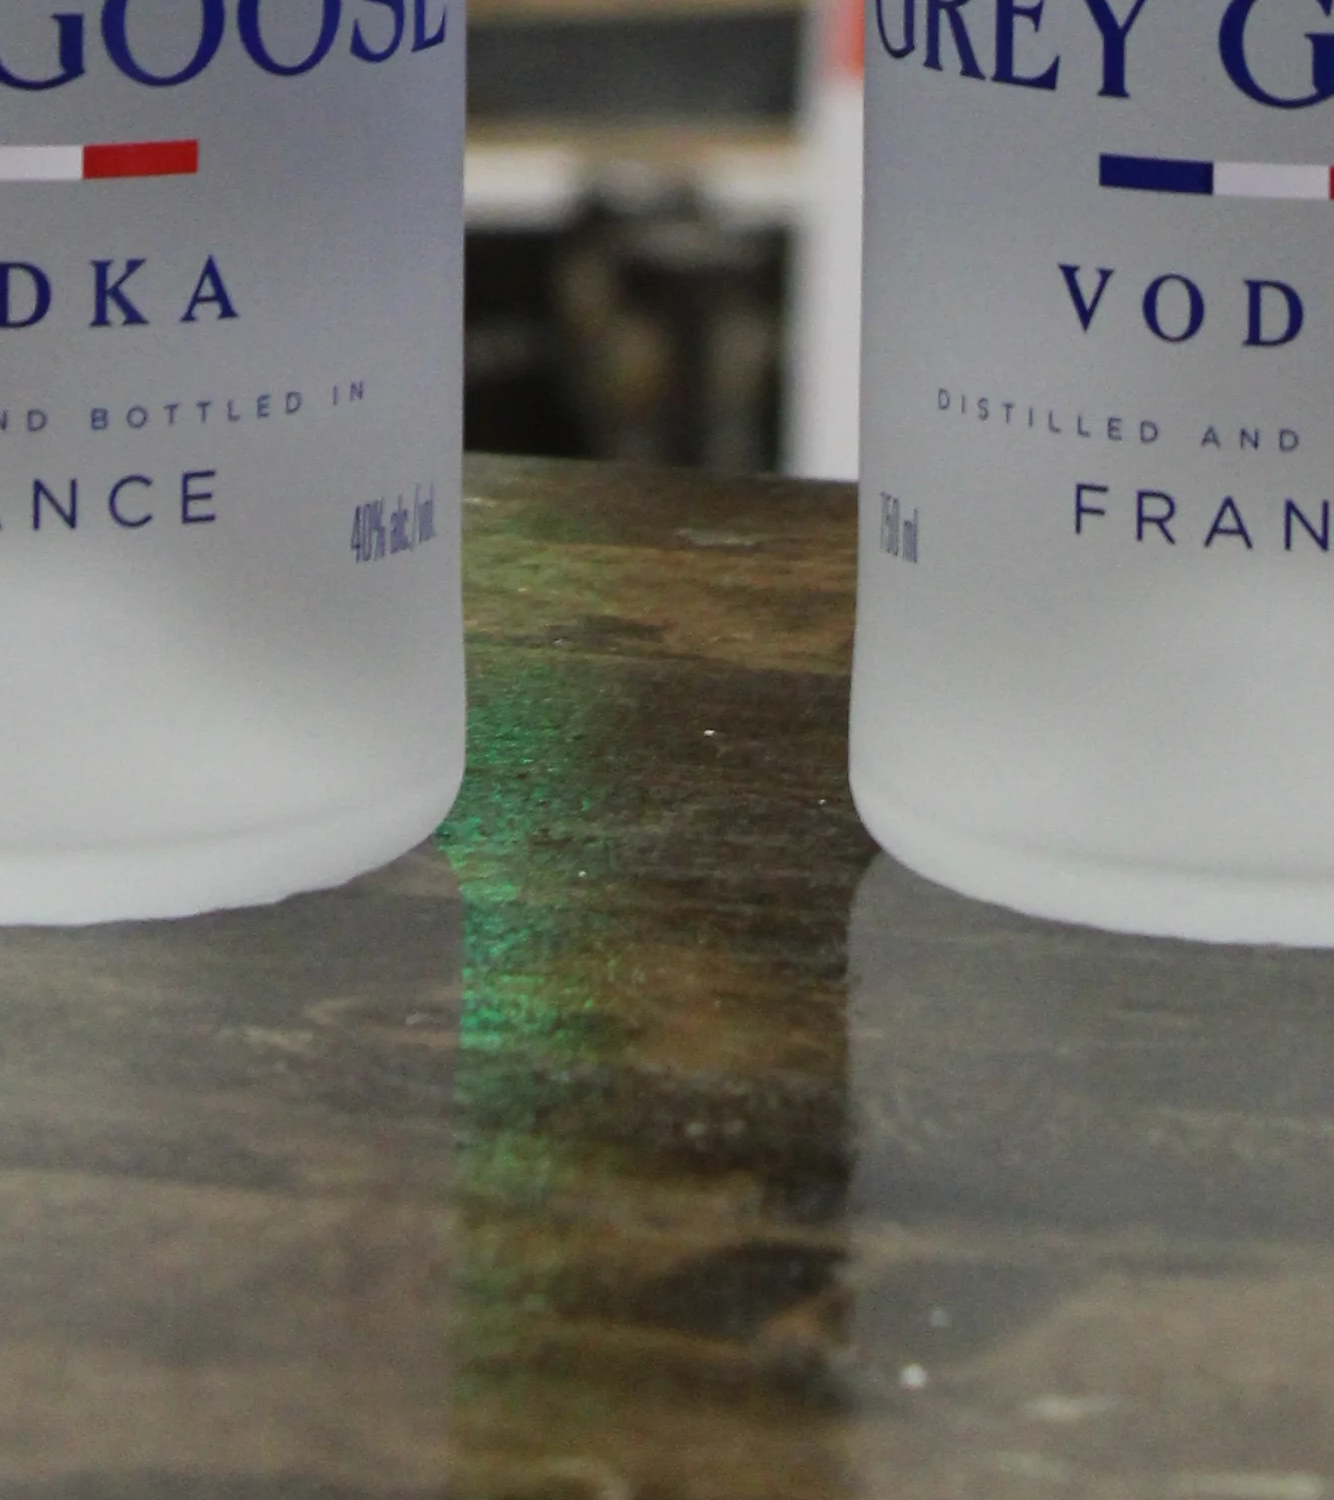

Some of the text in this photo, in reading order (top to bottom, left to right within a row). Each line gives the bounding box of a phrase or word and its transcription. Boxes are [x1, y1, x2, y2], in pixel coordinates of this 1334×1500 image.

[90, 390, 303, 431] BOTTLED
[332, 380, 365, 406] IN
[937, 388, 1160, 445] DISTILLED
[1200, 425, 1300, 453] AND
[350, 496, 386, 564] 40%
